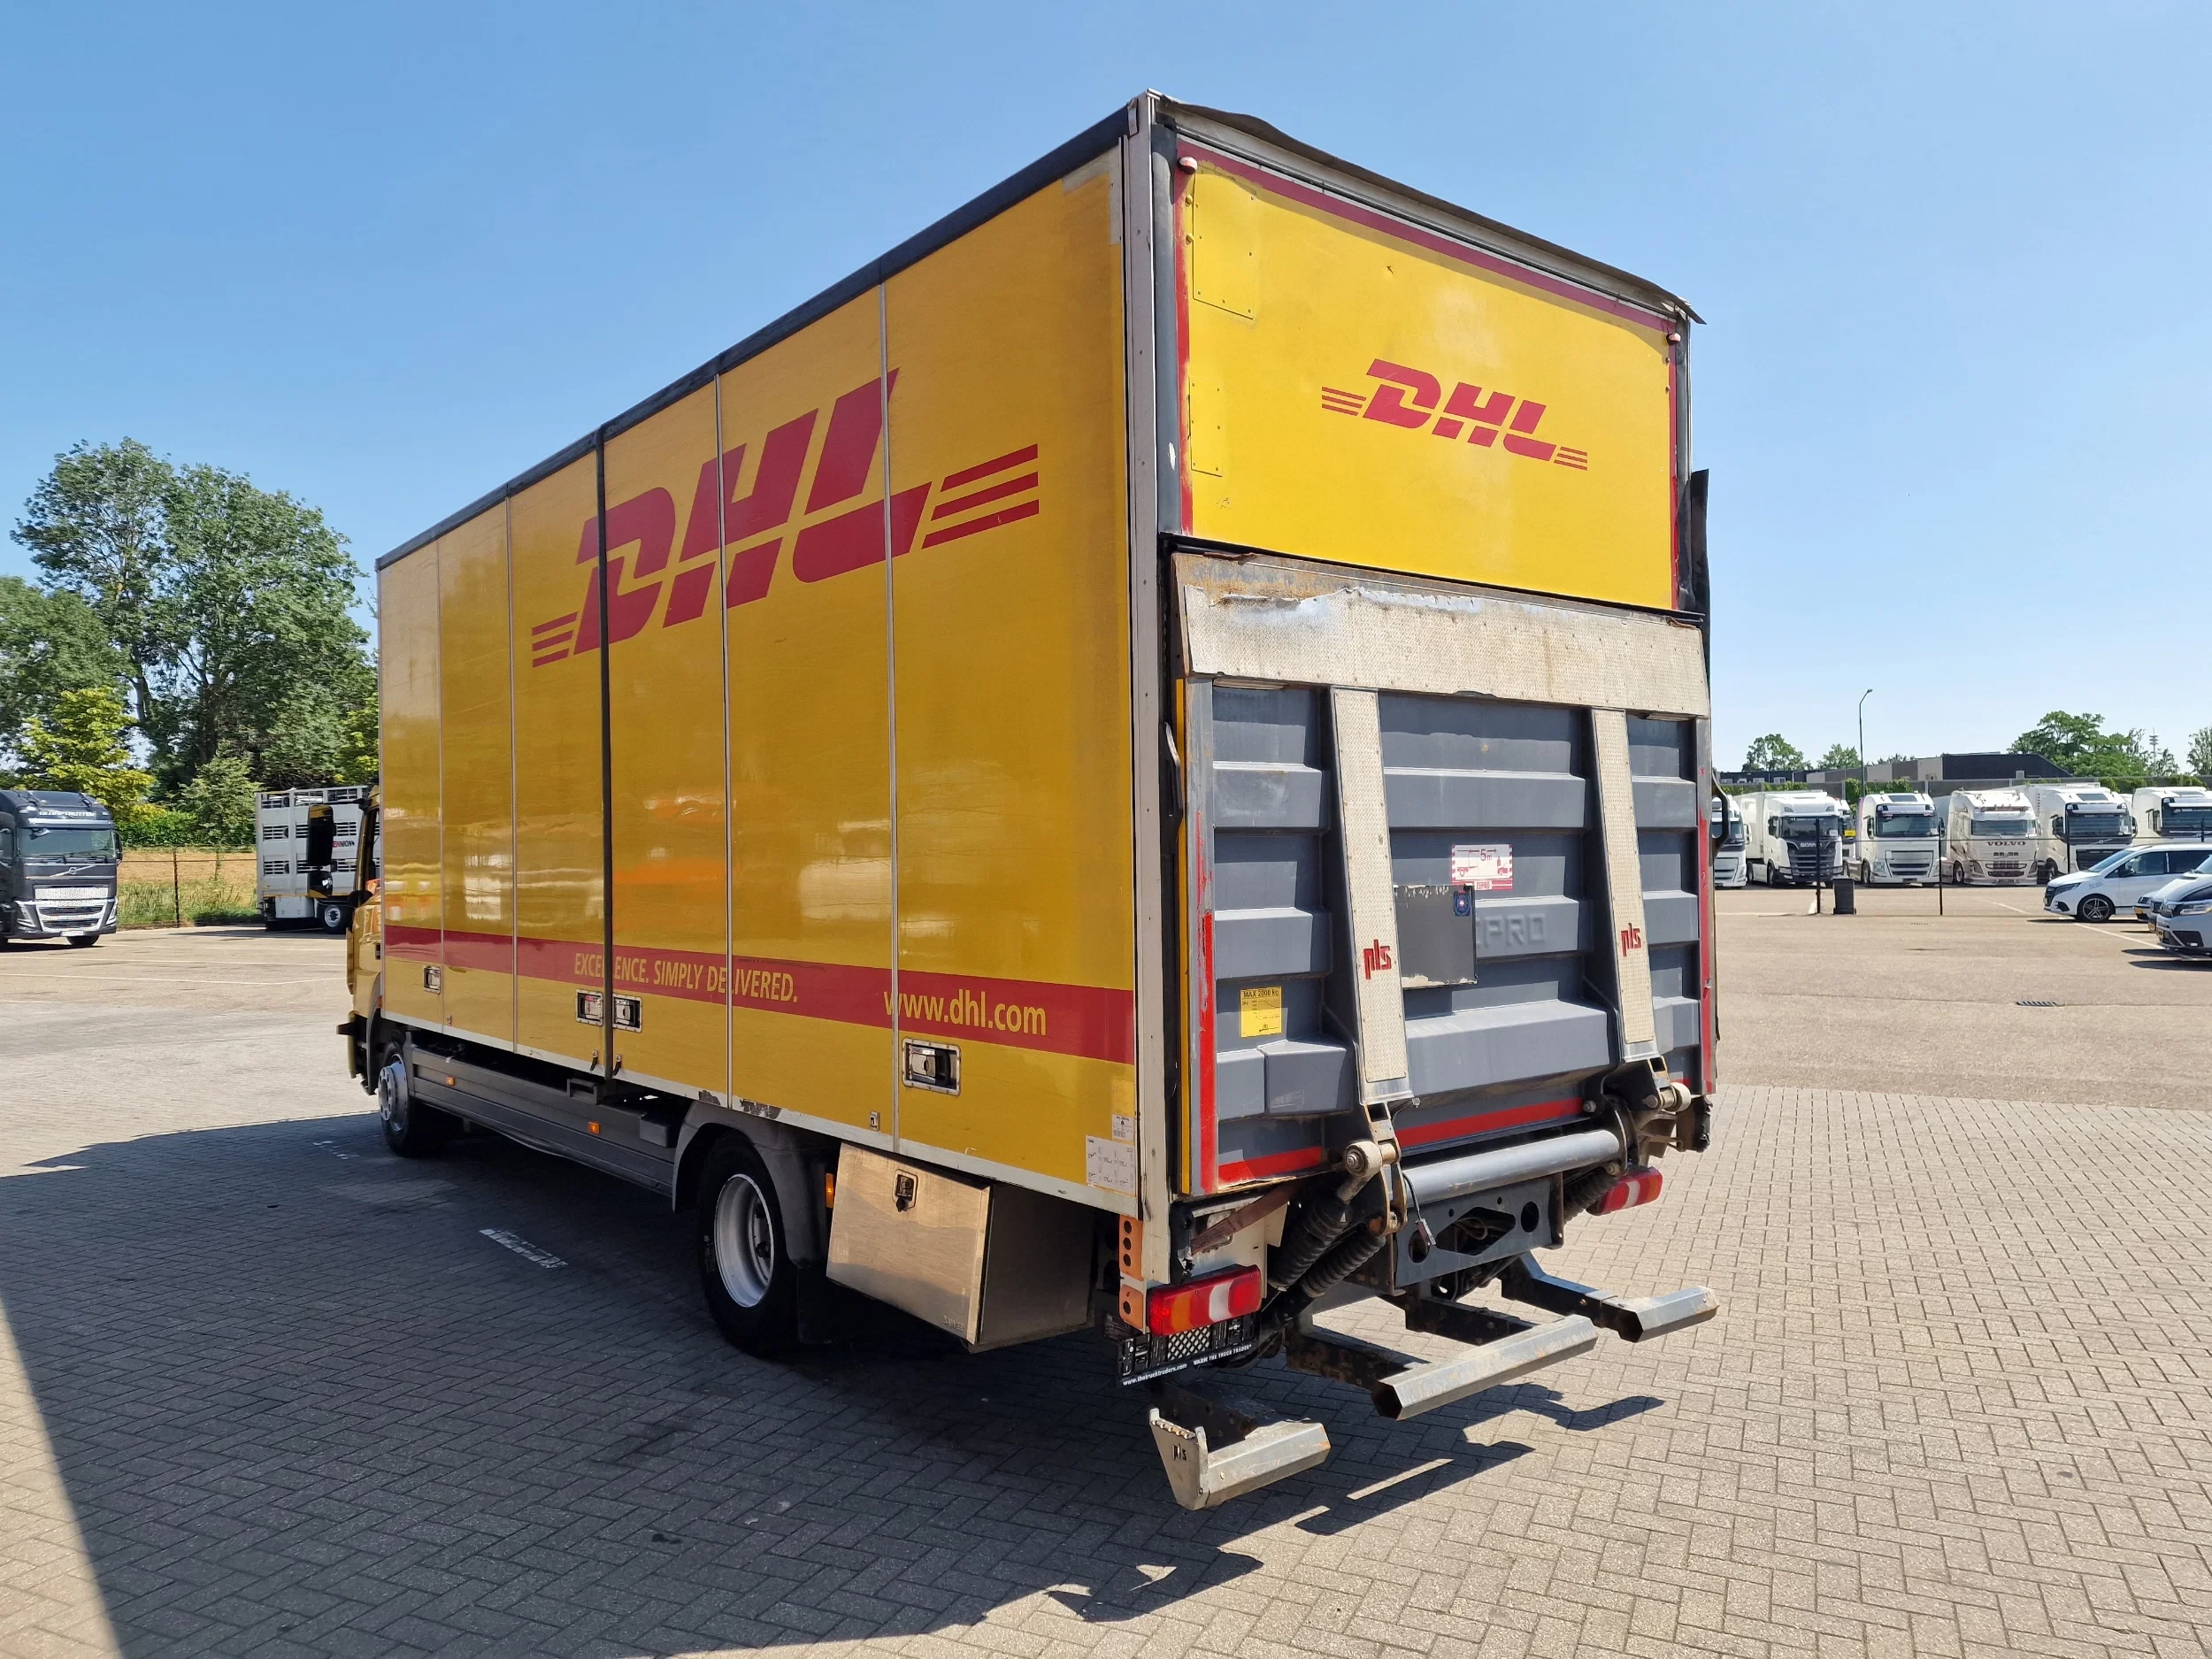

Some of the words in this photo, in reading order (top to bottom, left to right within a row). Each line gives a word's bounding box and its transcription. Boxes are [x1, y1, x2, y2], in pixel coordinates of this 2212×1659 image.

[1363, 358, 1557, 461] DHL
[573, 367, 933, 656] DHL
[1475, 912, 1546, 948] PRO
[1621, 923, 1642, 957] pls
[574, 952, 649, 984] EXCEENCE.
[653, 960, 704, 990] SIMPLY
[706, 965, 798, 1003] DEIVERED.
[1363, 939, 1393, 980] pls
[883, 988, 1047, 1036] www.dhl.com
[1243, 989, 1256, 998] MAX
[1272, 988, 1279, 997] kg
[1217, 1349, 1233, 1359] TRUCK
[1123, 1363, 1187, 1386] www.thetrucktraders.com
